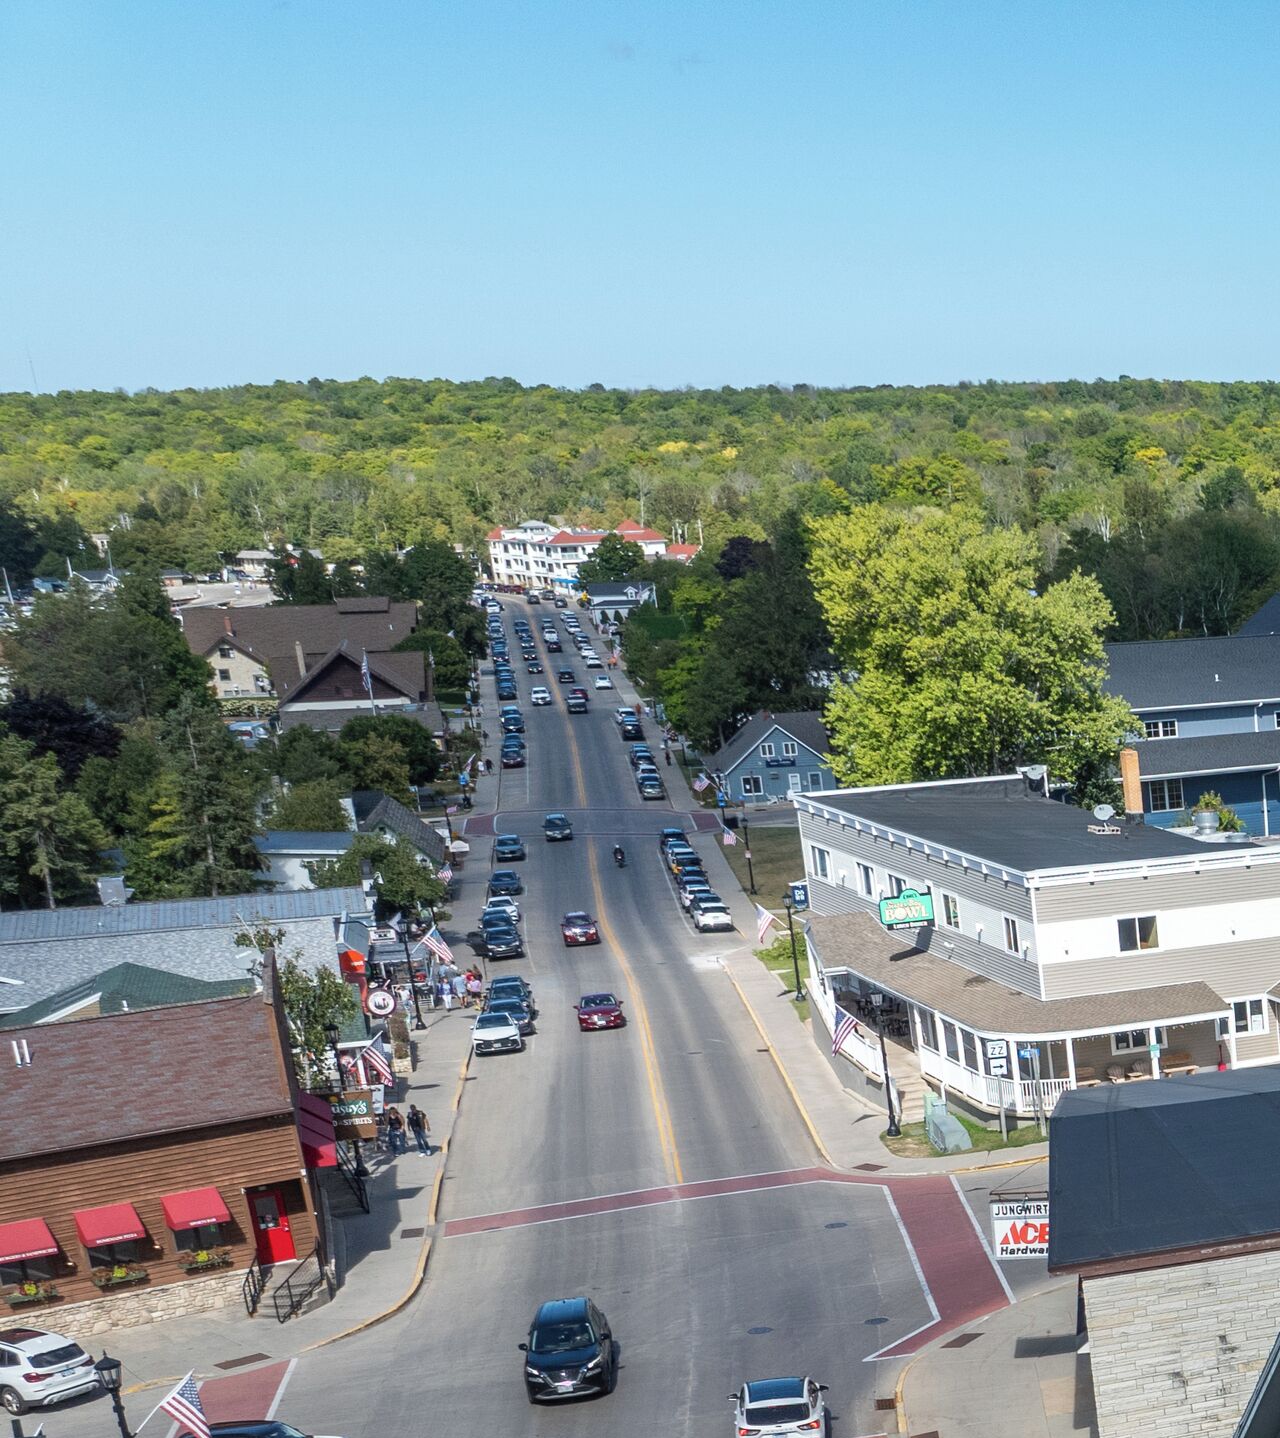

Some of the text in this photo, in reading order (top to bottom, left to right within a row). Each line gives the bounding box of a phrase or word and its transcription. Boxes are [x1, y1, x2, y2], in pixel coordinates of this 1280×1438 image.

[885, 905, 930, 921] BOWL
[994, 1204, 1048, 1216] JUNGWIRT
[1000, 1221, 1049, 1245] ACE
